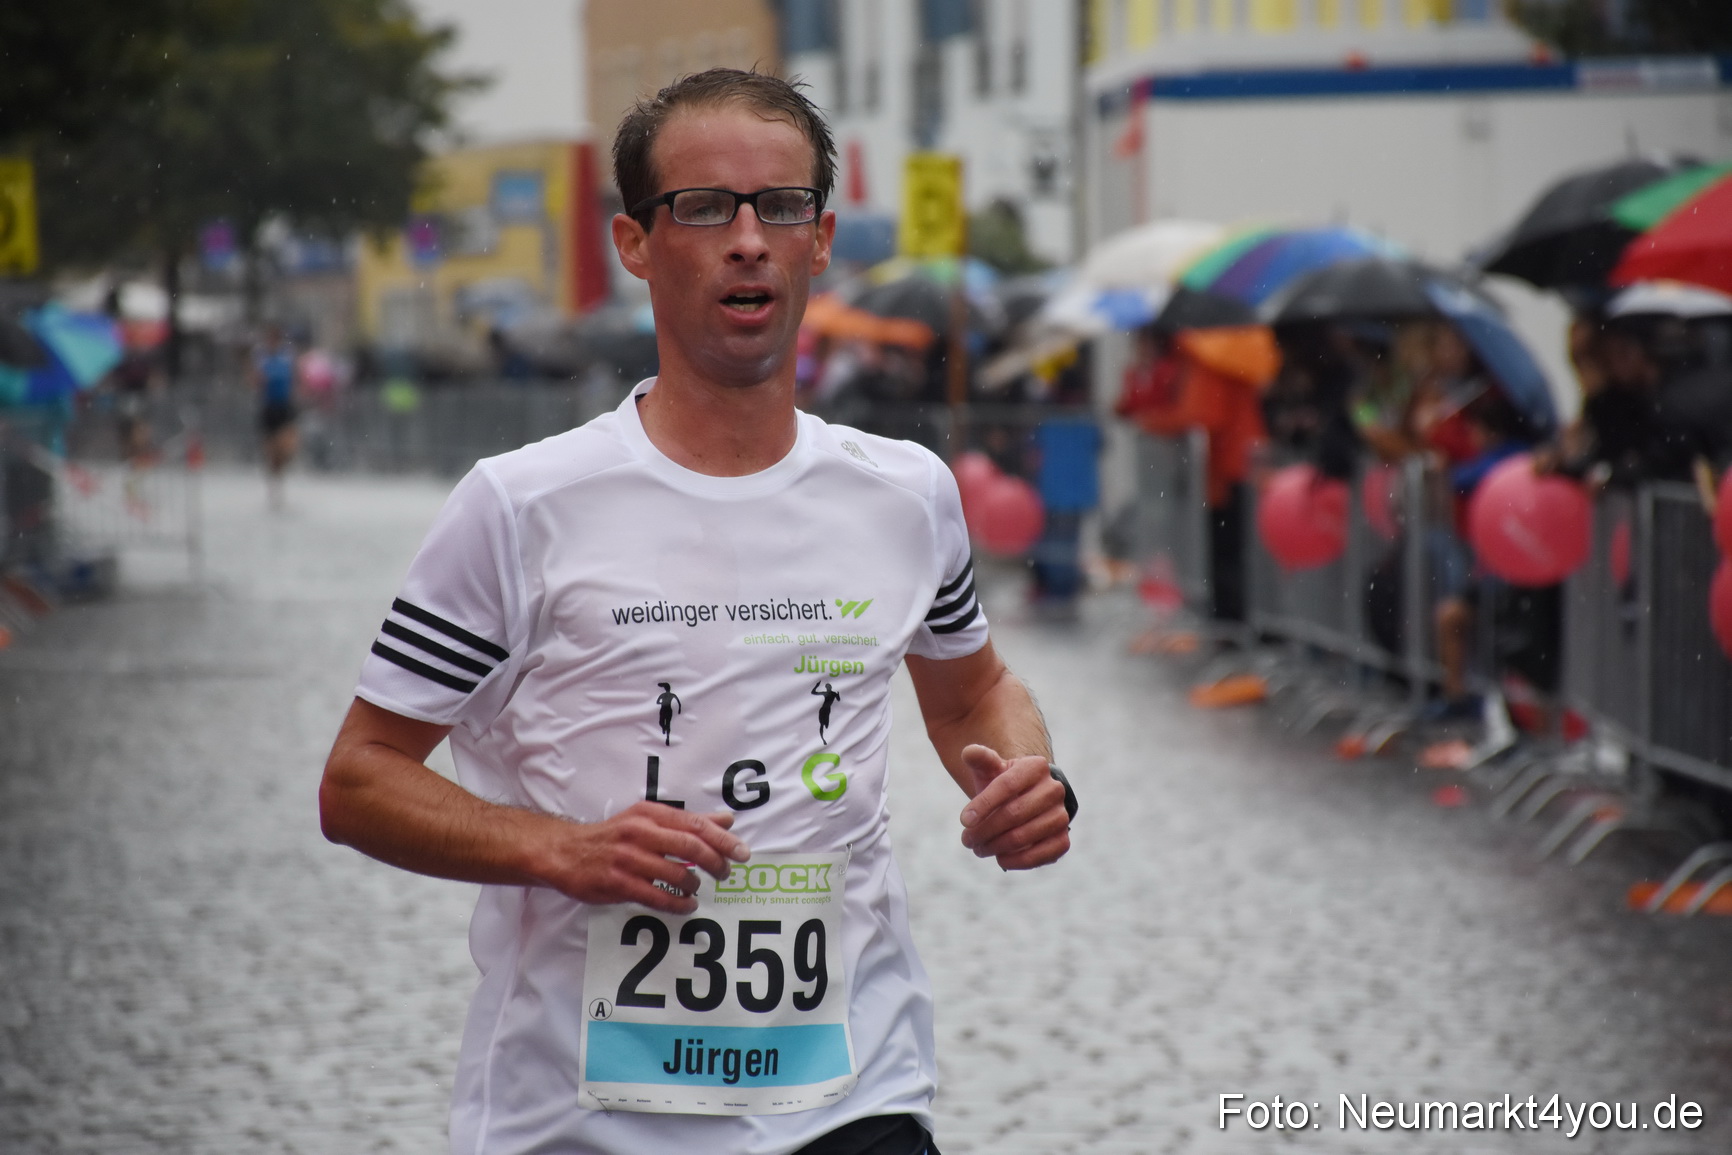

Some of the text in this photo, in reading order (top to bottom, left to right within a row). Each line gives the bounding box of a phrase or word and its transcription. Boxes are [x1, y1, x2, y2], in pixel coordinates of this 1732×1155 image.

[611, 598, 833, 627] weidinger versichert.
[743, 633, 880, 647] einfach. gut. versichert.
[794, 655, 865, 678] Jürgen
[645, 753, 847, 811] L G G
[715, 864, 832, 893] BOCK
[714, 895, 831, 905] inspired by smart concepts
[615, 914, 829, 1013] 2359
[594, 1001, 607, 1018] A
[663, 1038, 779, 1085] Jürgen
